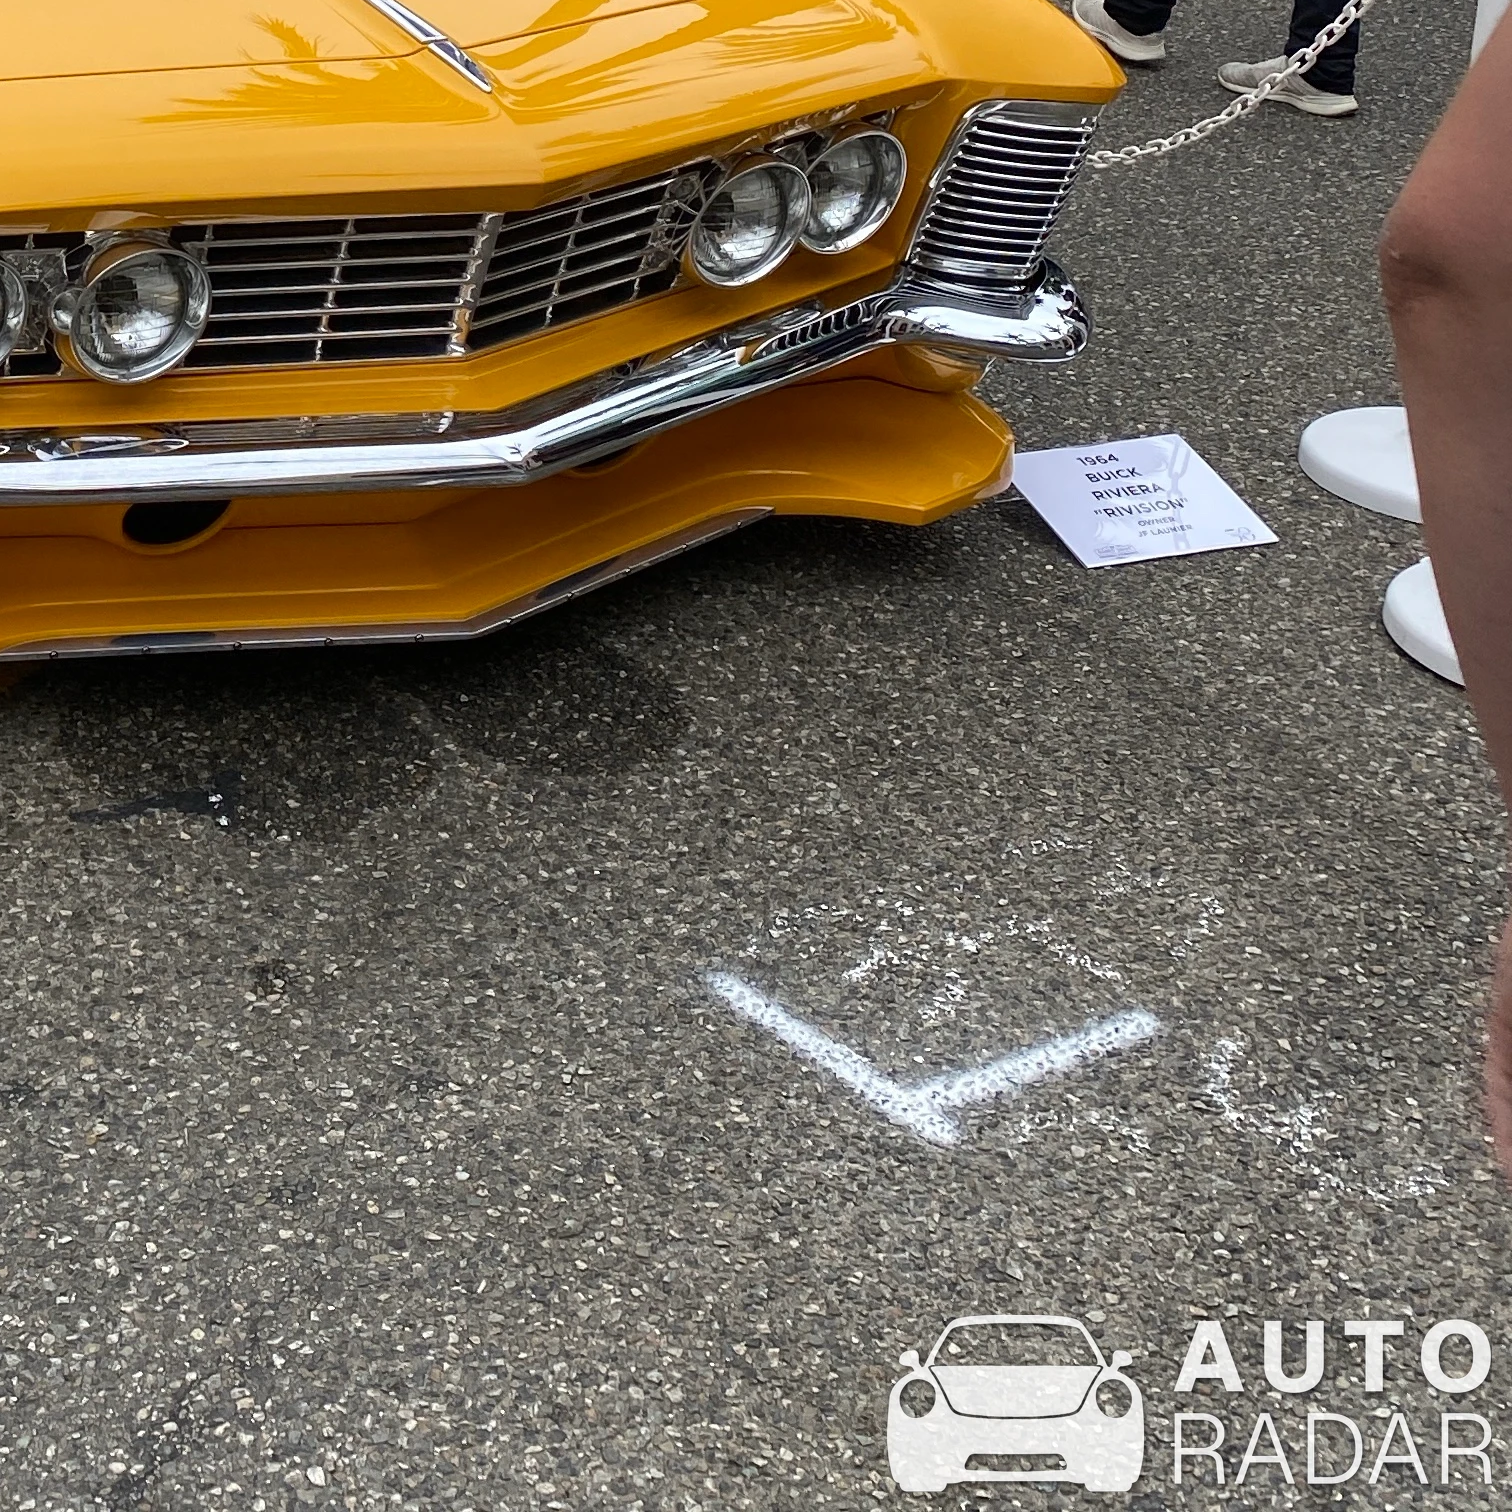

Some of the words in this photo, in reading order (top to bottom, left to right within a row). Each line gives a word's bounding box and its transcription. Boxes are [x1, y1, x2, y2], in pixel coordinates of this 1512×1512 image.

[1076, 453, 1120, 466] 1964
[1085, 466, 1143, 483] BUICK
[1091, 483, 1166, 501] RIVIERA
[1093, 497, 1188, 518] "RIVISION"
[1137, 516, 1176, 527] OWNER
